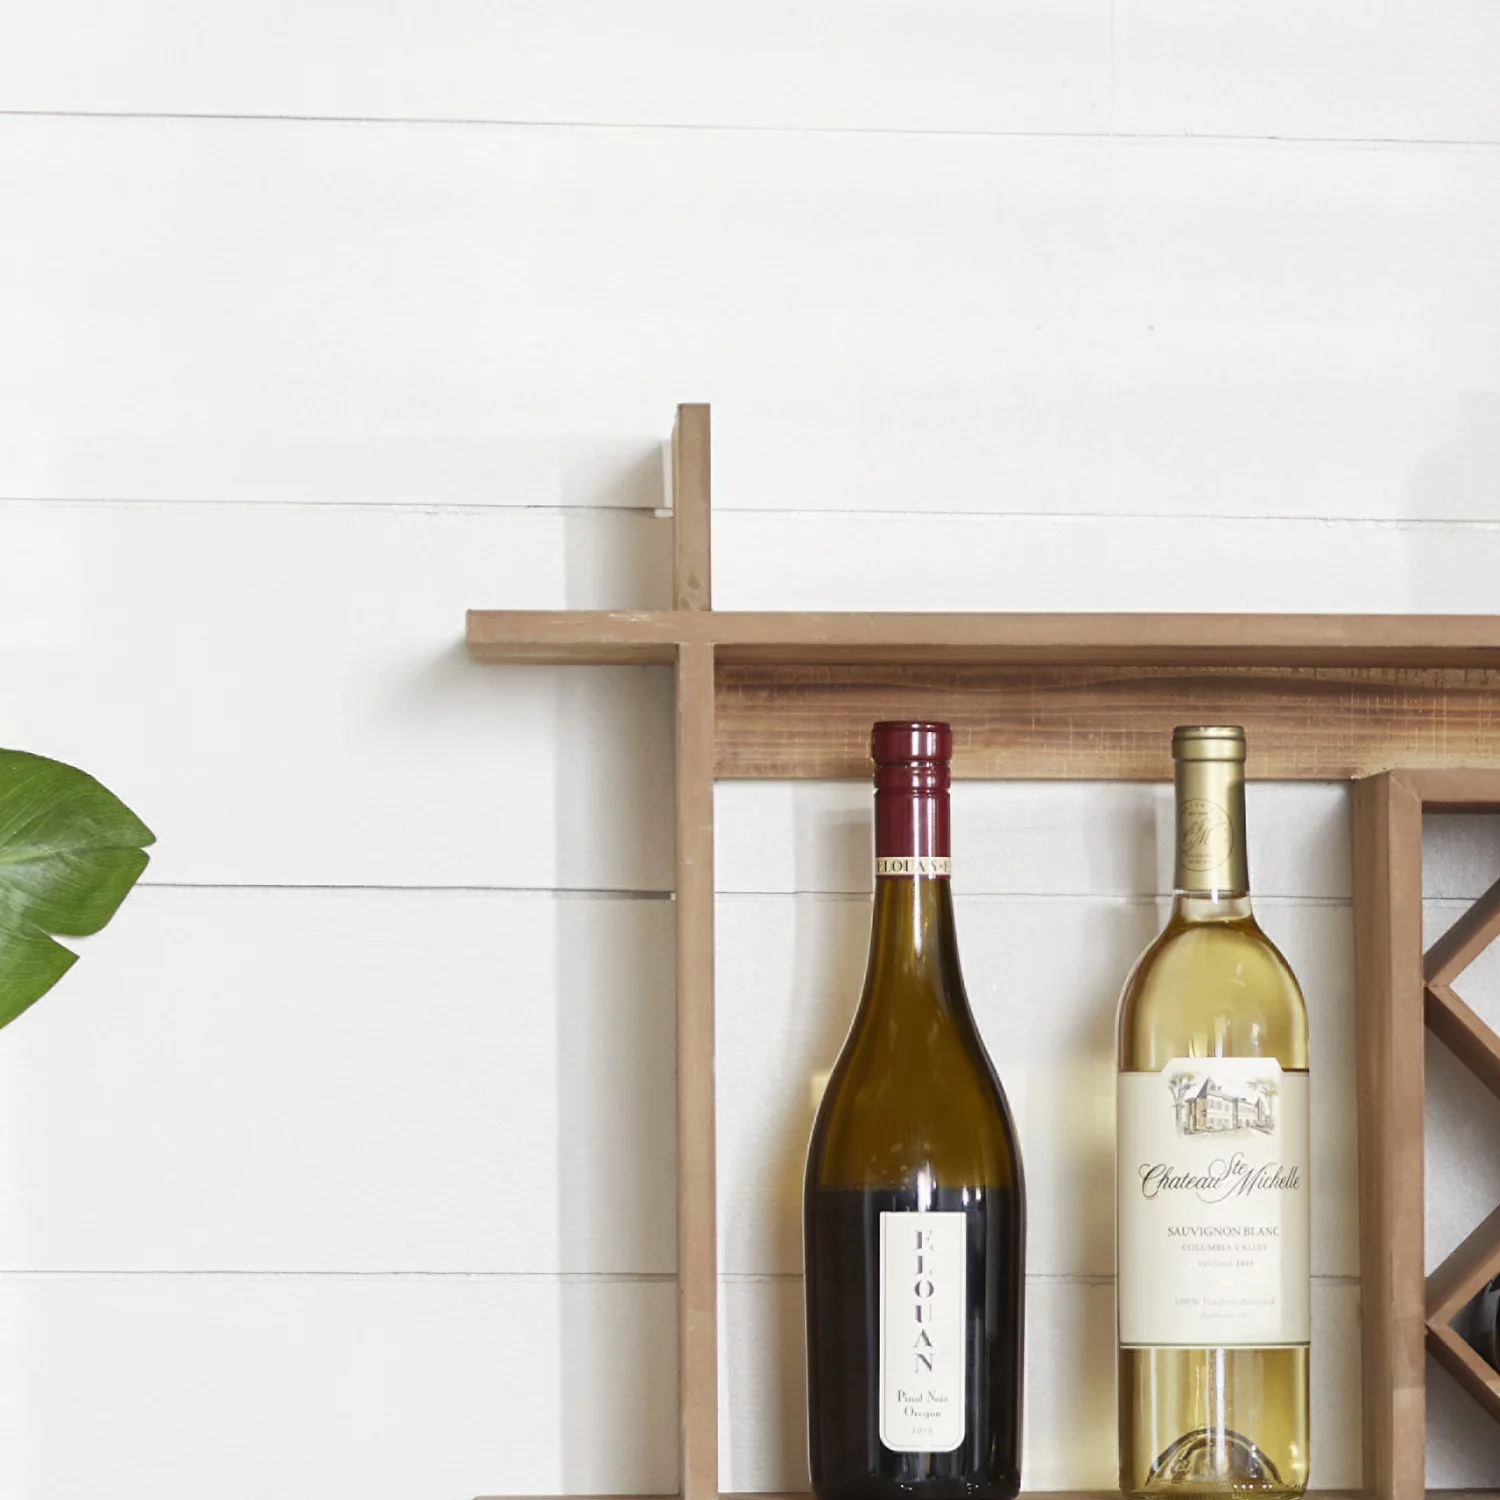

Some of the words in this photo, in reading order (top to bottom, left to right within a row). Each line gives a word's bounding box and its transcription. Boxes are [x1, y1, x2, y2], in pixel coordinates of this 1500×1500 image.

[1208, 1151, 1249, 1181] Ste
[1139, 1163, 1222, 1199] Chateau
[1196, 1162, 1301, 1204] Michelle
[1167, 1225, 1241, 1238] SAUVIGNON
[1243, 1225, 1280, 1238] BLANC
[1181, 1243, 1232, 1252] COLUMBIA
[1234, 1243, 1269, 1252] VALLEY
[913, 1229, 936, 1375] ELOUAN
[896, 1389, 923, 1403] Pinot
[927, 1389, 949, 1403] Noir
[904, 1405, 942, 1419] Oregon
